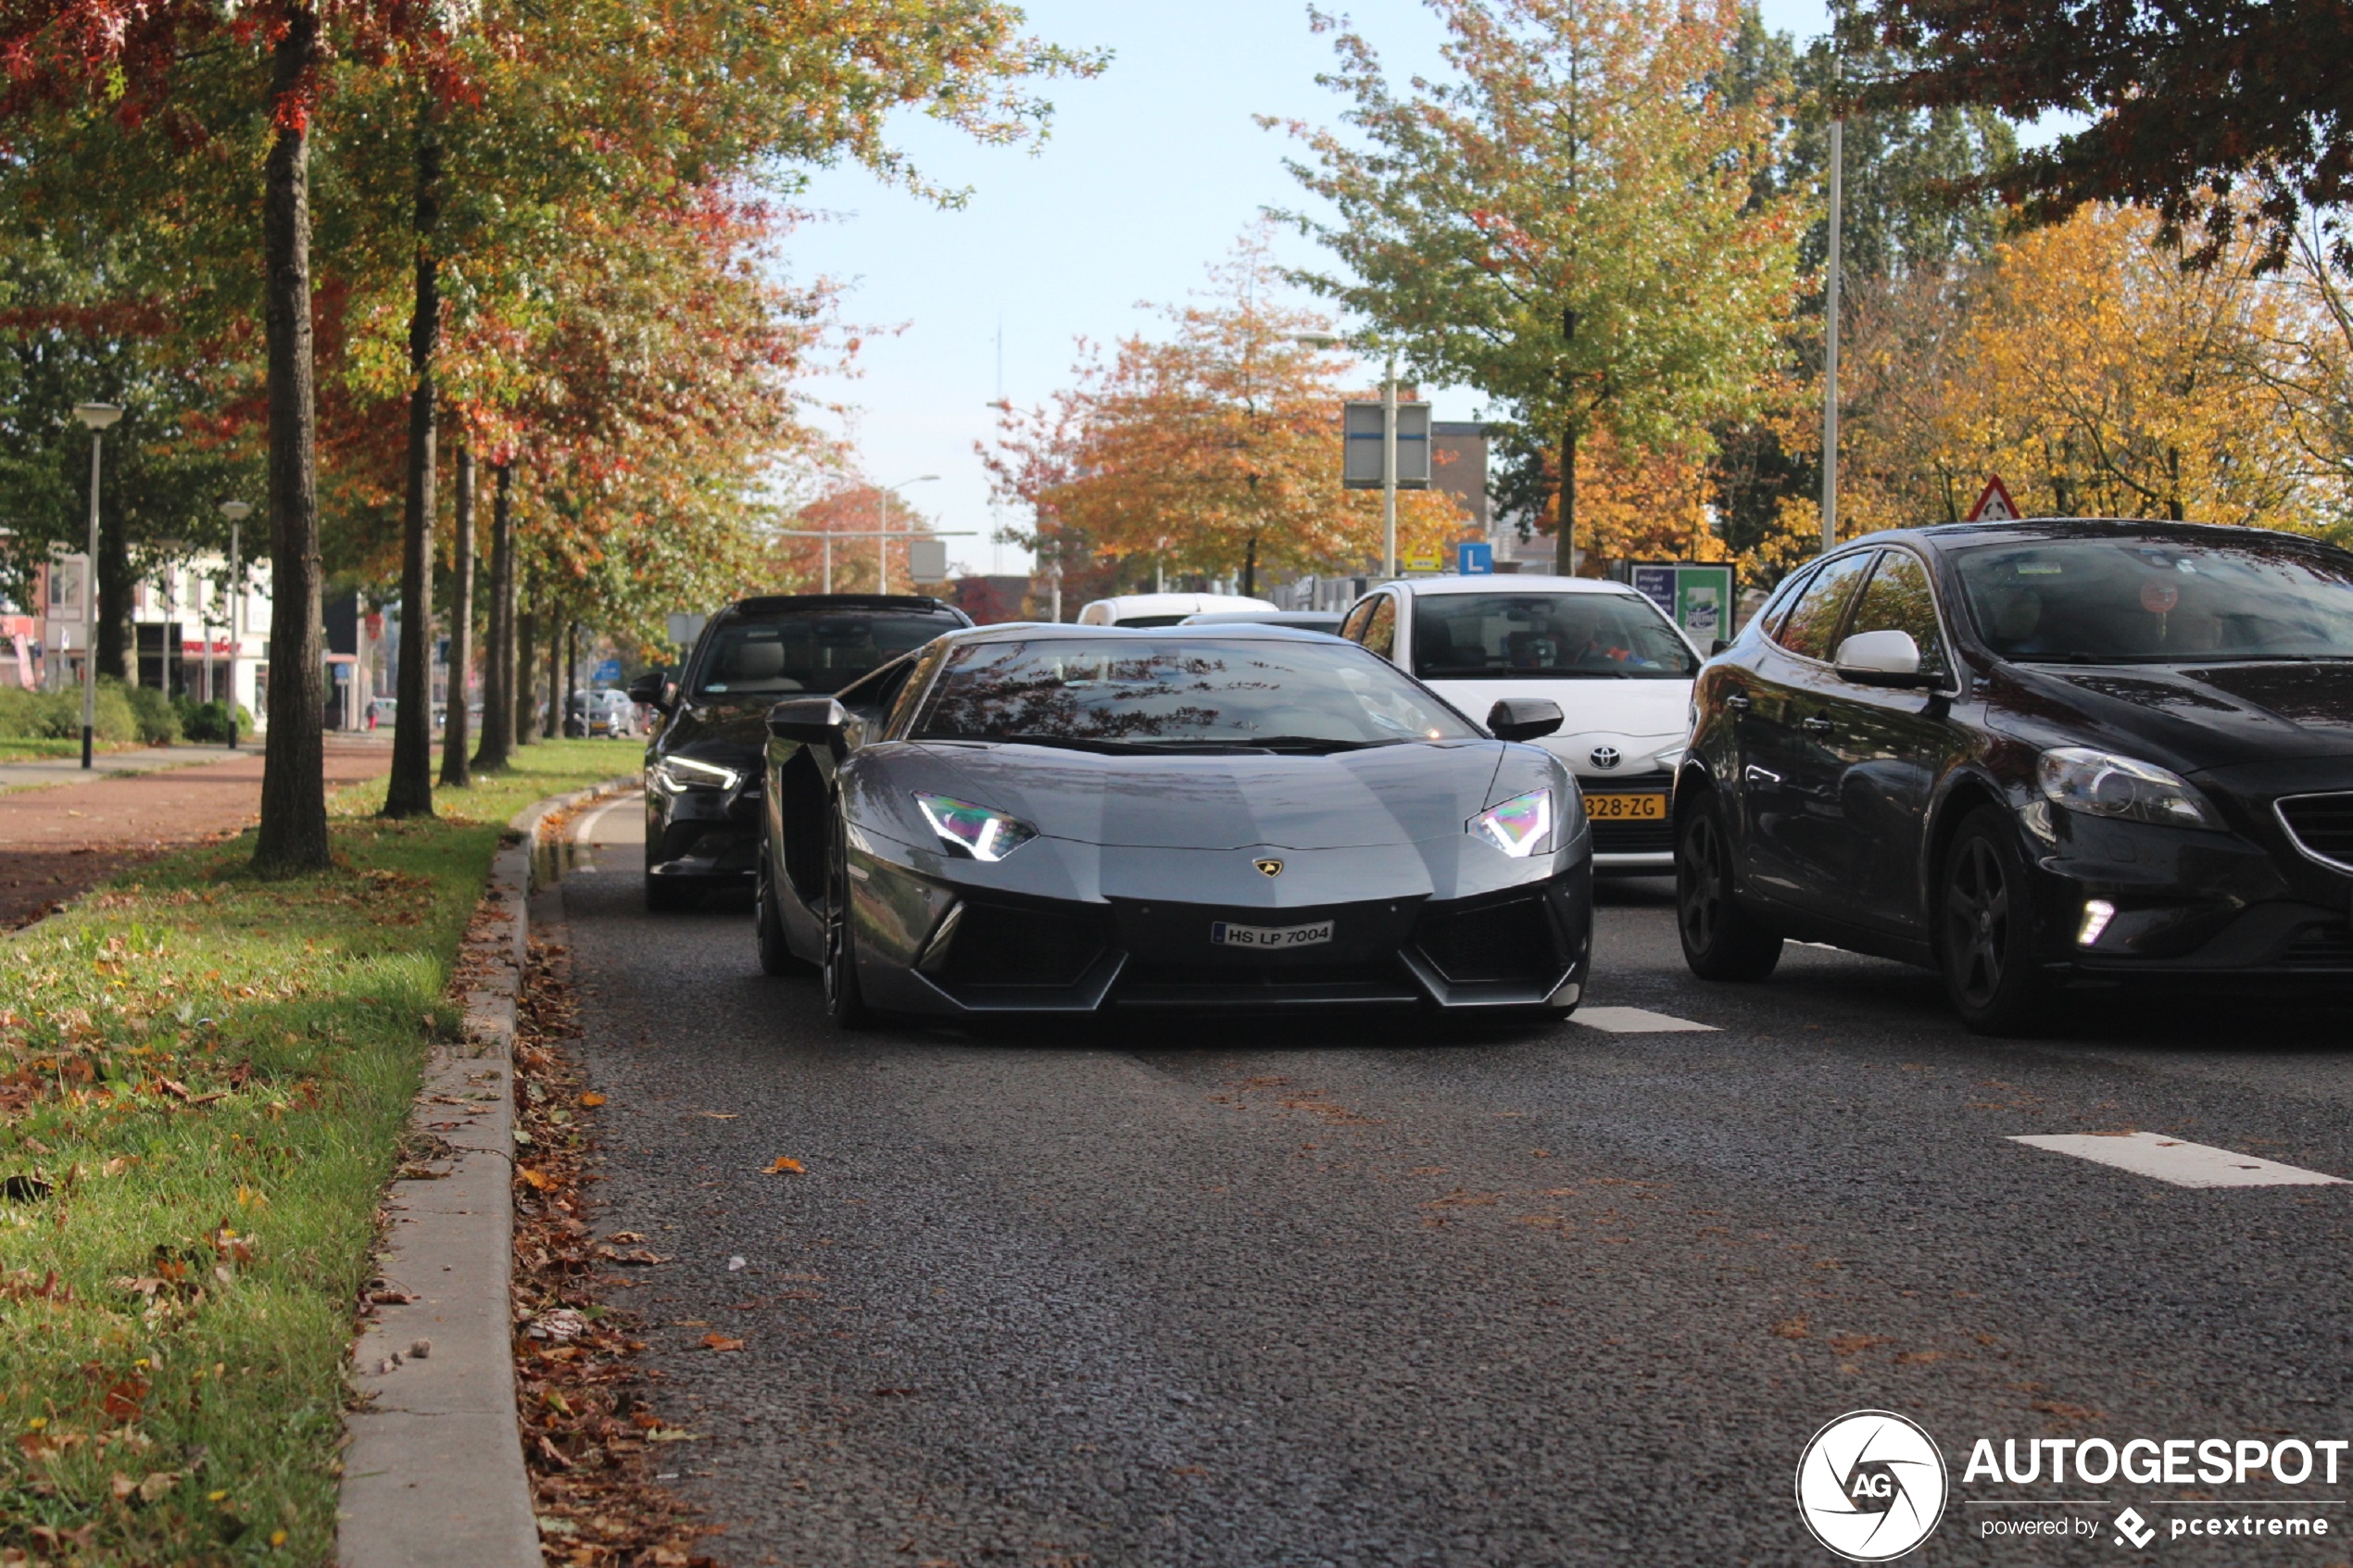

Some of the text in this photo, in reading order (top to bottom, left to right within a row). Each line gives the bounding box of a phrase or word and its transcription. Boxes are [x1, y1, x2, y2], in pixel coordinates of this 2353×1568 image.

[1467, 549, 1484, 571] L
[1228, 927, 1329, 946] HS LP 7004
